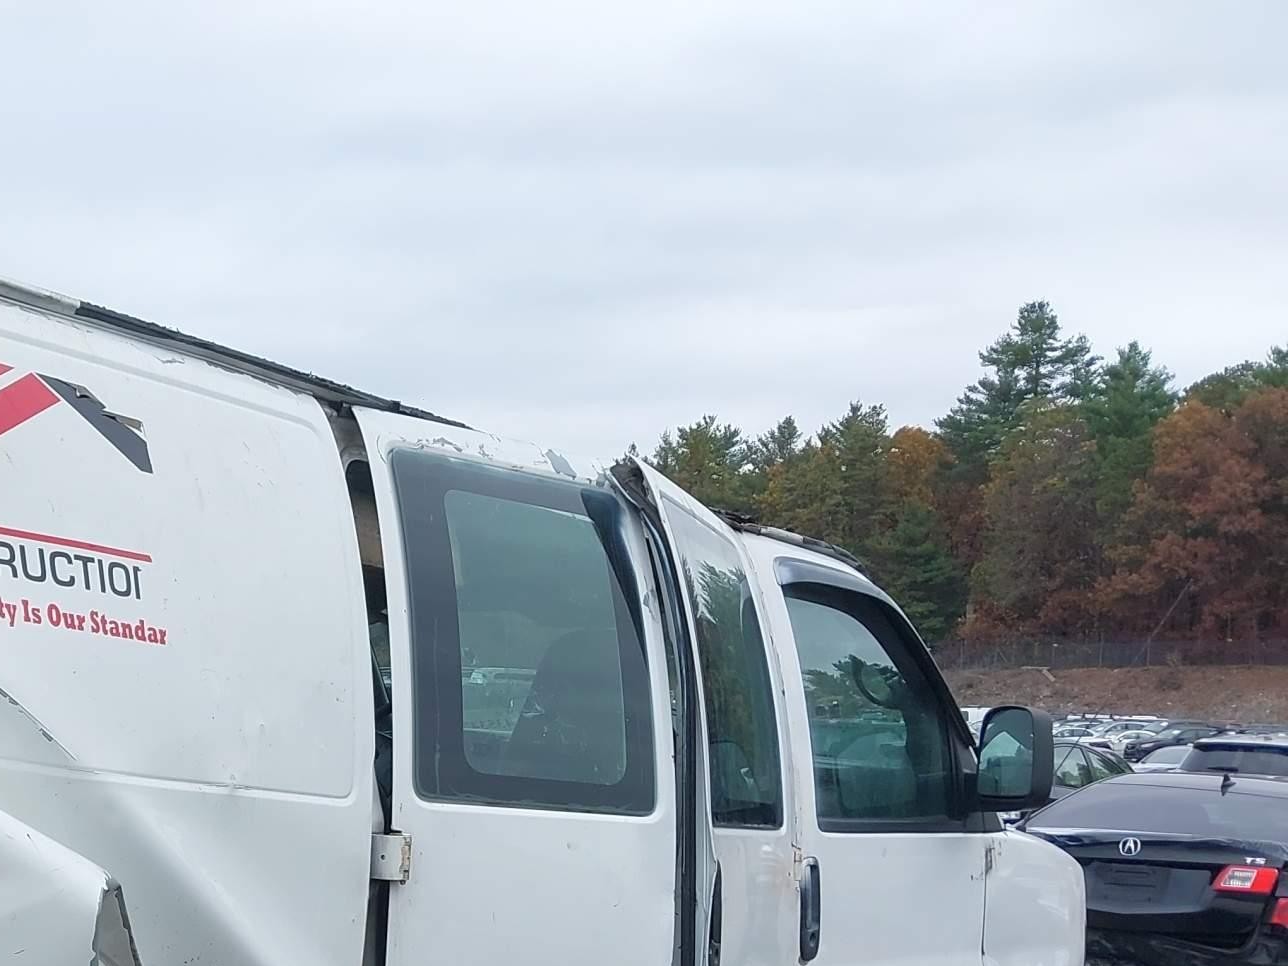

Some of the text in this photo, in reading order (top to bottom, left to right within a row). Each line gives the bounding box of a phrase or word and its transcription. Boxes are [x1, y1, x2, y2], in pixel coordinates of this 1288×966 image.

[23, 599, 42, 625] Is
[47, 603, 85, 632] Our
[90, 610, 167, 646] Standar
